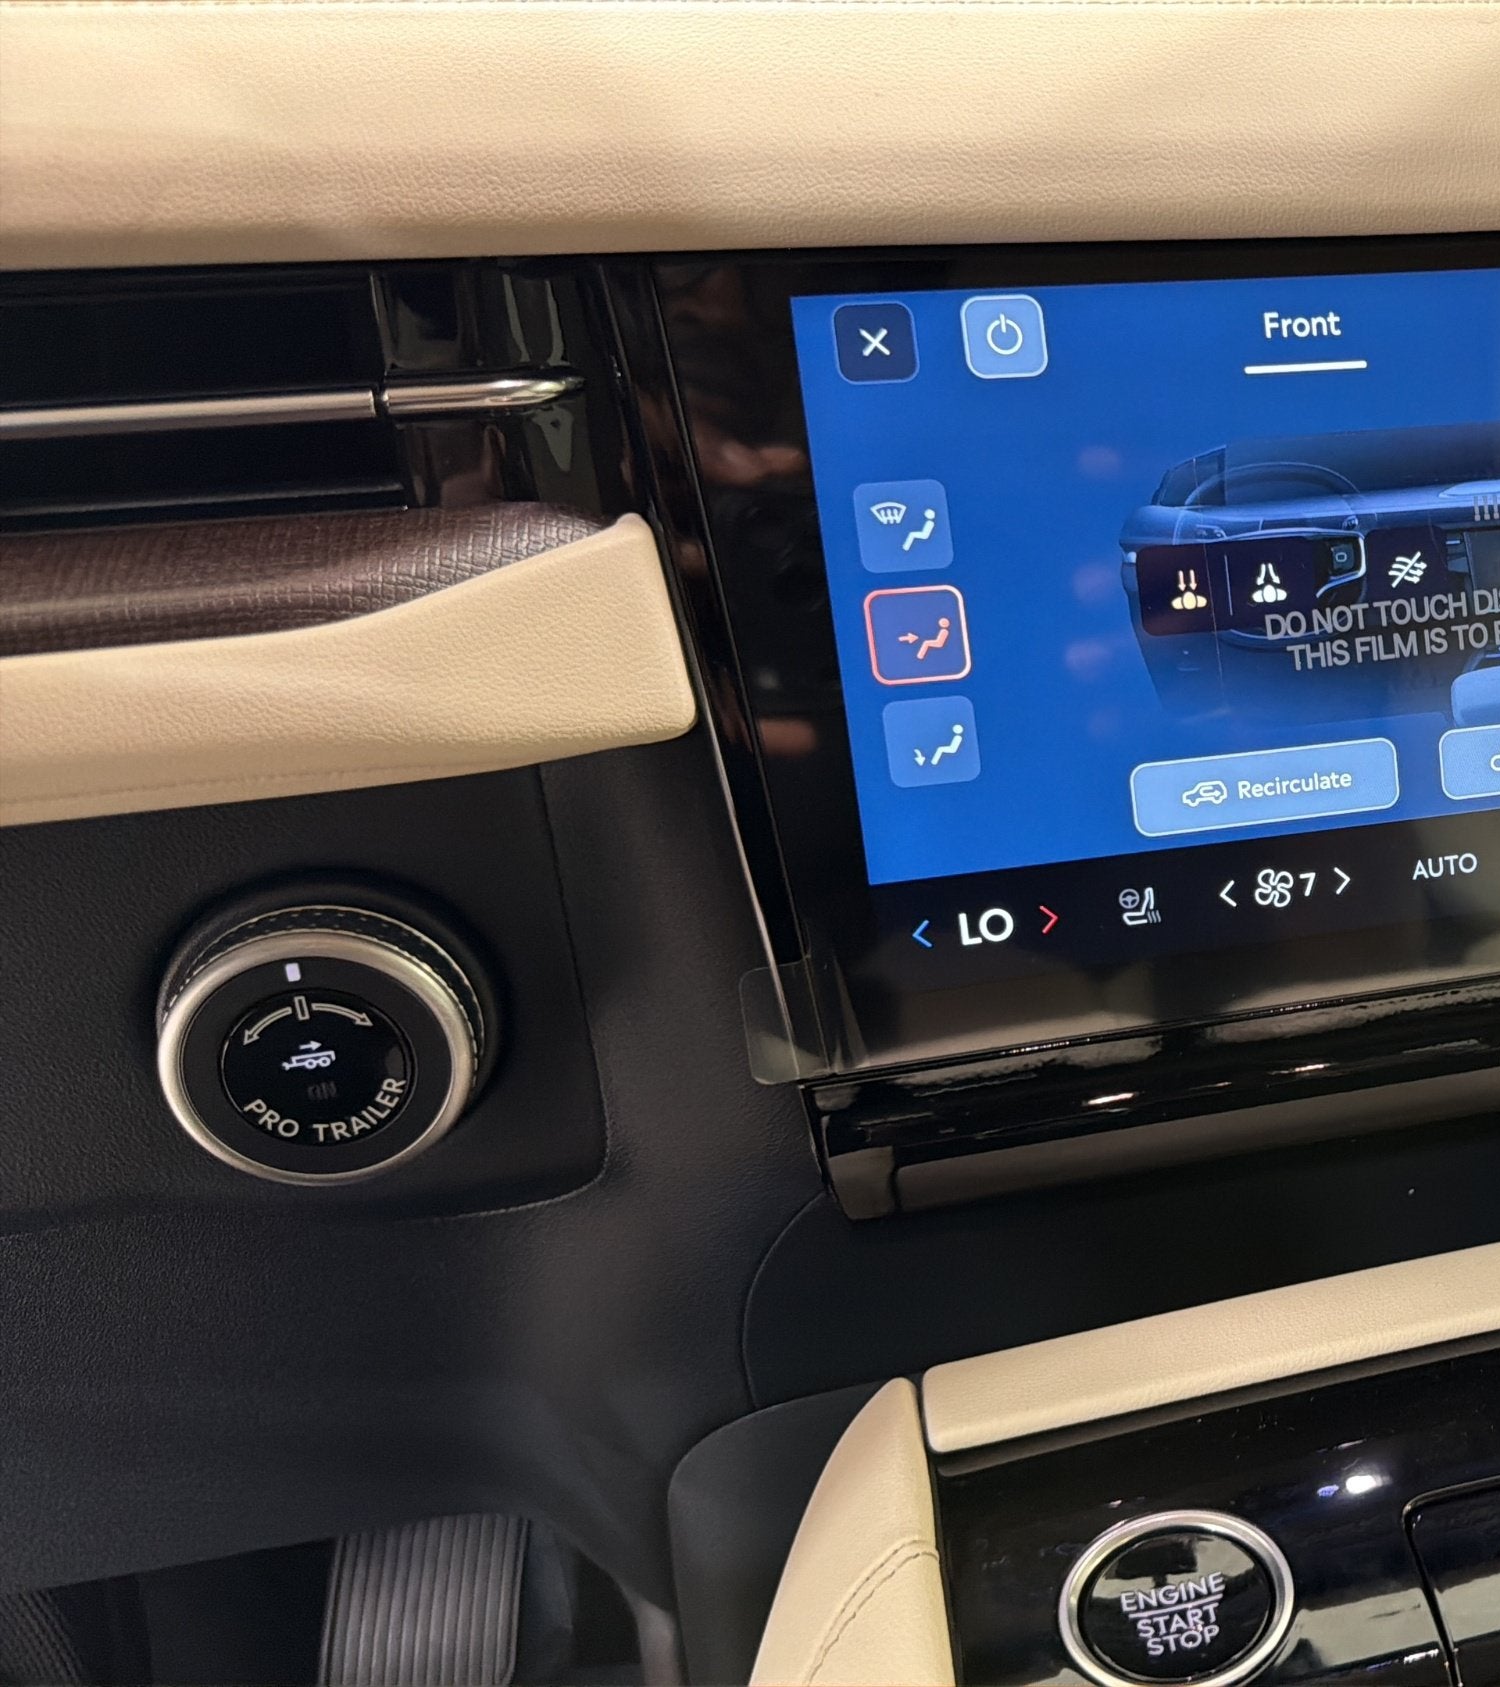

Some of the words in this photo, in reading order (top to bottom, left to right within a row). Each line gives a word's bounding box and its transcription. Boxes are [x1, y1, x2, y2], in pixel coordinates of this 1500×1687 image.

[1264, 311, 1342, 340] Front
[1265, 611, 1307, 641] DO
[1312, 603, 1369, 635] NOT
[1373, 591, 1468, 627] TOUCH
[1287, 640, 1351, 671] THIS
[1355, 629, 1419, 664] FILM
[1424, 626, 1448, 655] IS
[1451, 622, 1489, 649] TO
[1237, 769, 1353, 799] Recirculate
[1299, 870, 1318, 898] 7
[1412, 852, 1478, 881] AUTO
[959, 908, 1014, 946] LO
[243, 1099, 300, 1138] PRO
[313, 1077, 406, 1142] TRAILER
[1120, 1571, 1226, 1612] ENGINE
[1136, 1602, 1220, 1638] START
[1146, 1624, 1220, 1656] STOP
